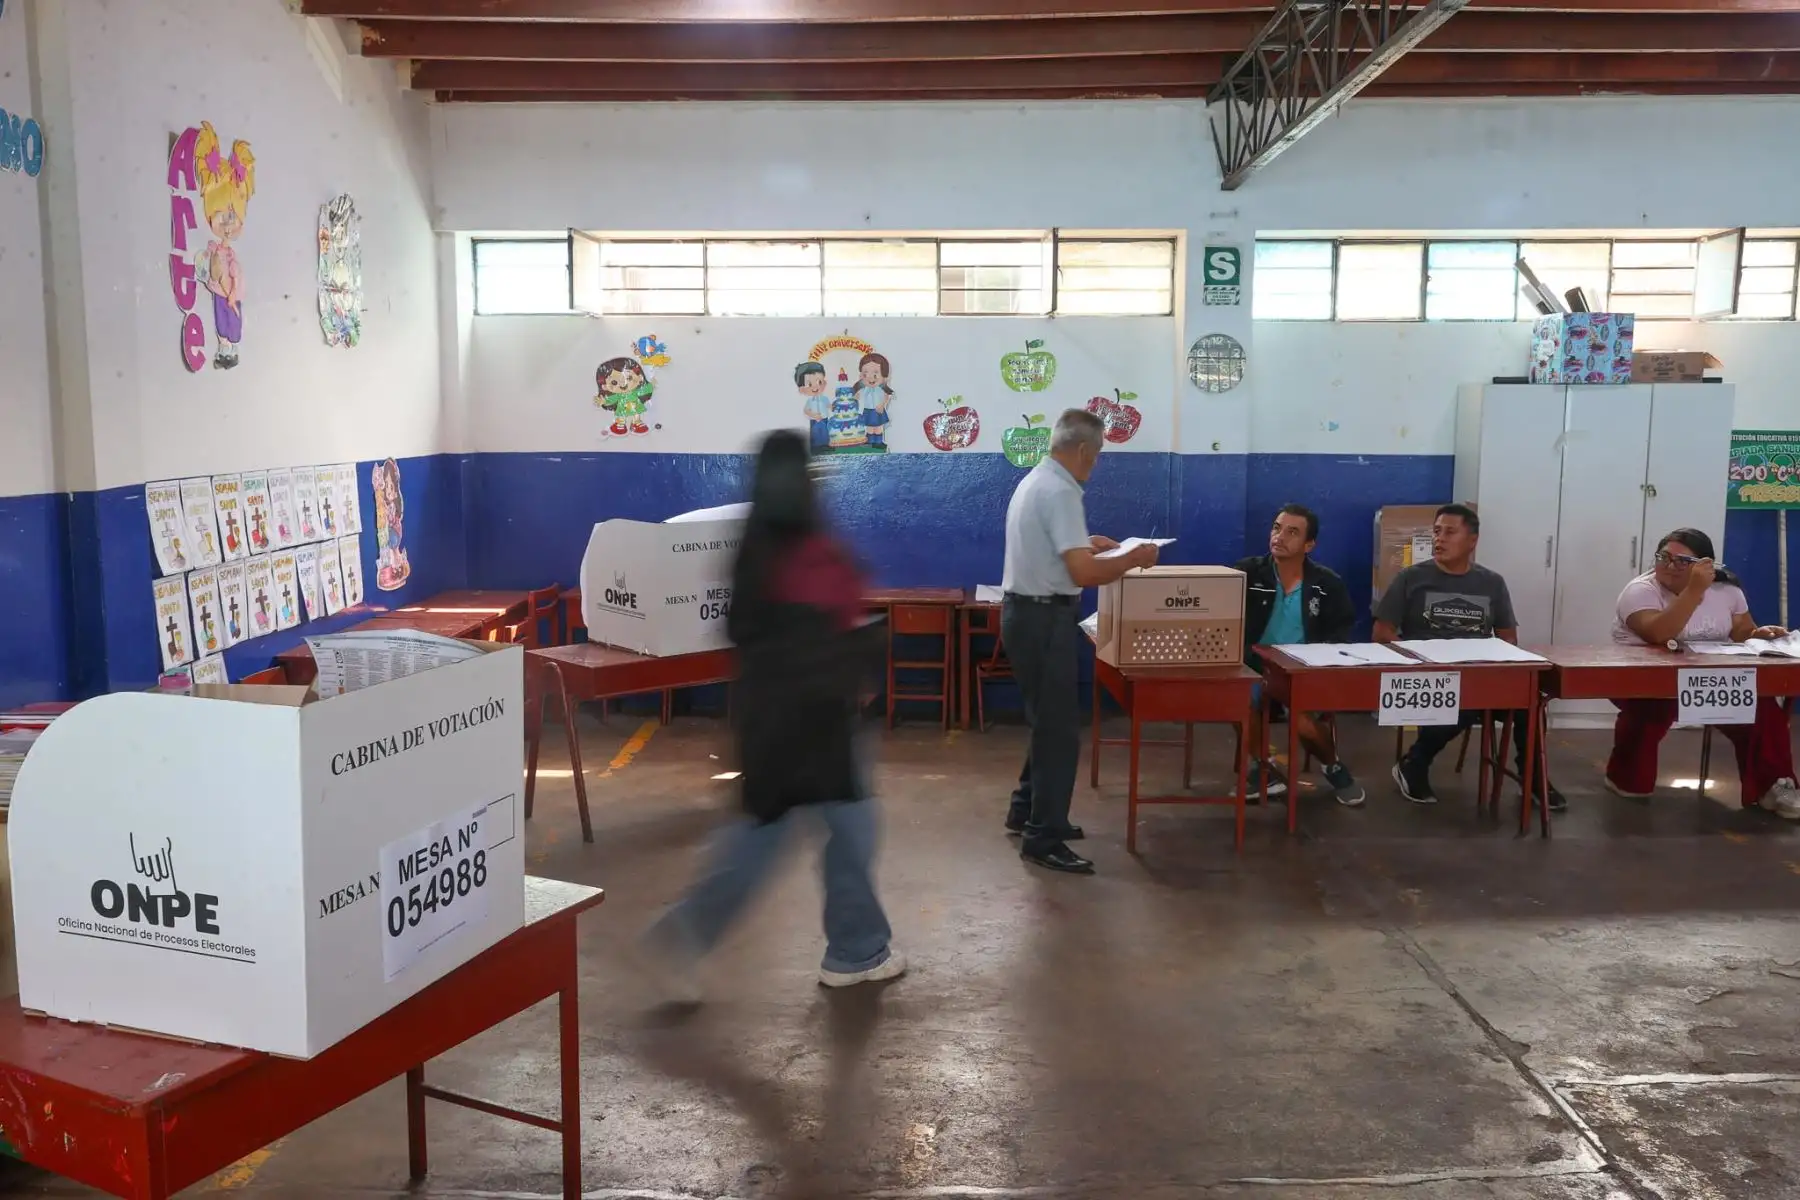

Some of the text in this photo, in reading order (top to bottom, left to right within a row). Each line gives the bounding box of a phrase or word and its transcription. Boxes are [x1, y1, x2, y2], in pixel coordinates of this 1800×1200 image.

[1209, 252, 1236, 280] S
[672, 542, 708, 553] CABINA
[710, 540, 722, 550] DE
[604, 588, 637, 609] ONPE
[664, 595, 690, 605] MESA
[706, 588, 732, 600] MES
[1165, 596, 1201, 608] ONPE
[700, 601, 729, 621] 054
[1391, 678, 1431, 690] MESA
[1688, 676, 1728, 688] MESA
[1381, 691, 1456, 709] 054988
[1680, 689, 1754, 707] 054988
[331, 697, 505, 775] CABINA DE VOTACIÓN
[398, 835, 453, 885] MESA
[319, 880, 367, 919] MESA
[388, 849, 487, 938] 054988
[91, 879, 220, 935] ONPE
[58, 916, 256, 958] Oficina Nacional de Procesos Electorales
